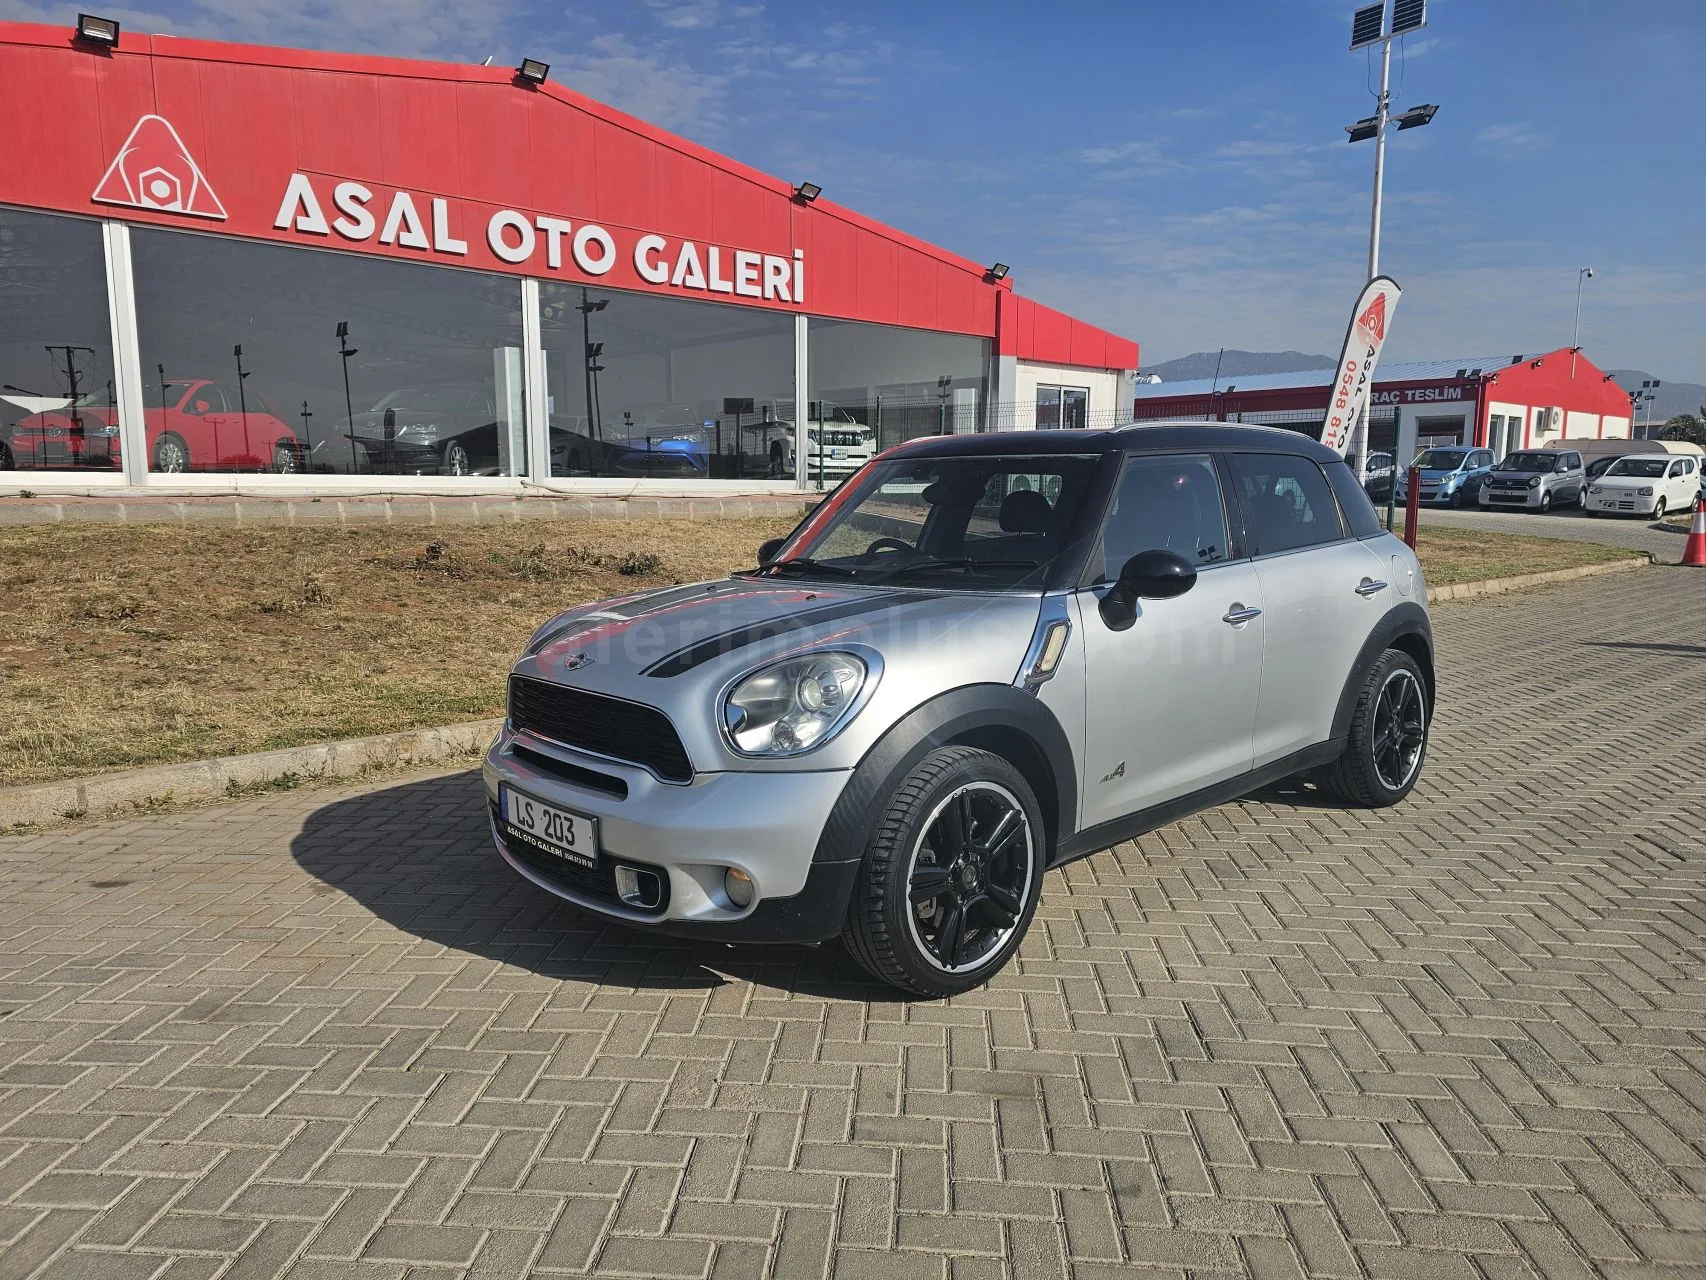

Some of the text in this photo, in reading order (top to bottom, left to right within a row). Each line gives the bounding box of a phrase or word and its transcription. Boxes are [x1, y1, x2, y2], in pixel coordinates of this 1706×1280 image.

[274, 173, 805, 303] ASAL OTO GALERİ
[1335, 360, 1357, 410] 0548
[1337, 343, 1376, 449] ASAL OTO
[1370, 385, 1462, 404] RAÇ TESLİM
[507, 826, 522, 839] ASAL
[523, 834, 537, 846] OTO
[515, 796, 575, 846] LS 203
